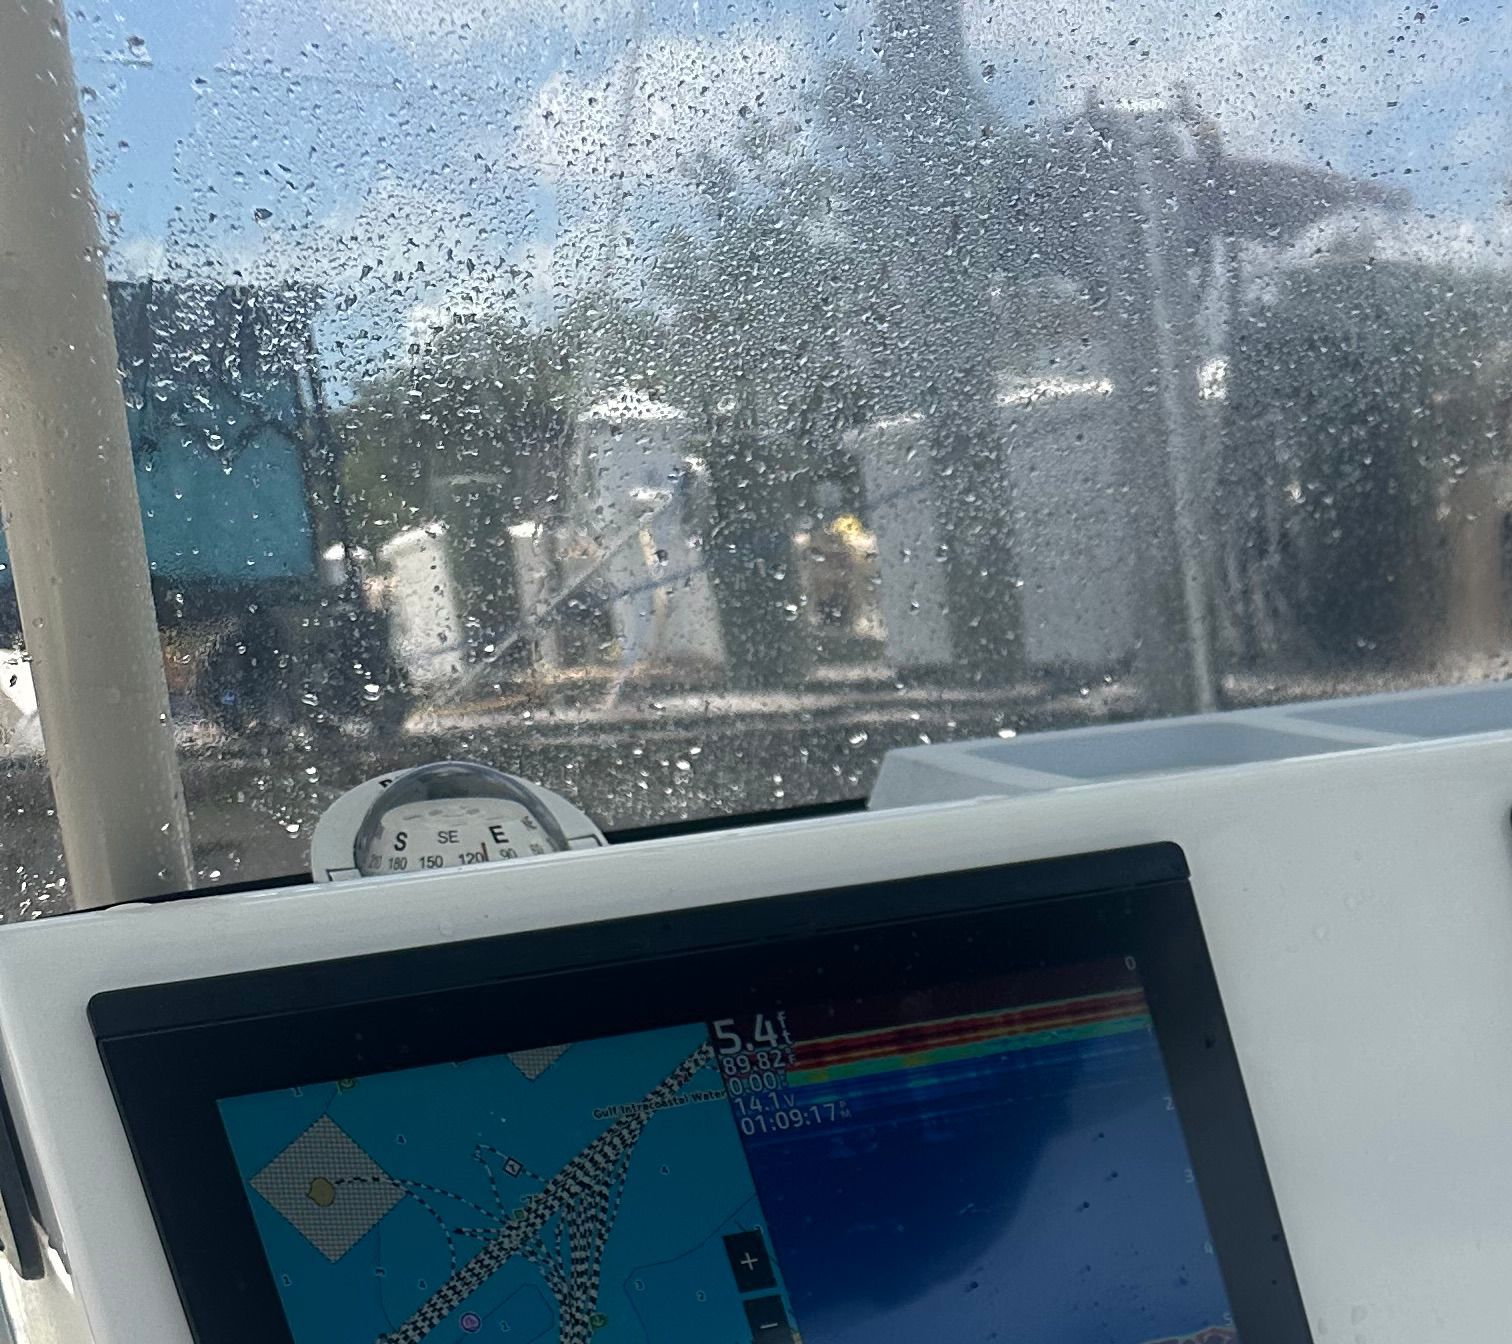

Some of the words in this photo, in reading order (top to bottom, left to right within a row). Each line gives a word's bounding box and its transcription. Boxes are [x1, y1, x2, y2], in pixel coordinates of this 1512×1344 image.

[394, 832, 407, 851] S
[437, 830, 459, 844] SE
[489, 825, 509, 844] E
[420, 855, 443, 869] 150
[458, 852, 483, 865] 120
[713, 1014, 778, 1054] 5.4
[722, 1049, 786, 1076] 89.82
[592, 1106, 618, 1120] Gulf
[690, 1088, 728, 1103] Water
[735, 1092, 780, 1116] 14.1
[741, 1102, 838, 1136] 01:09:17
